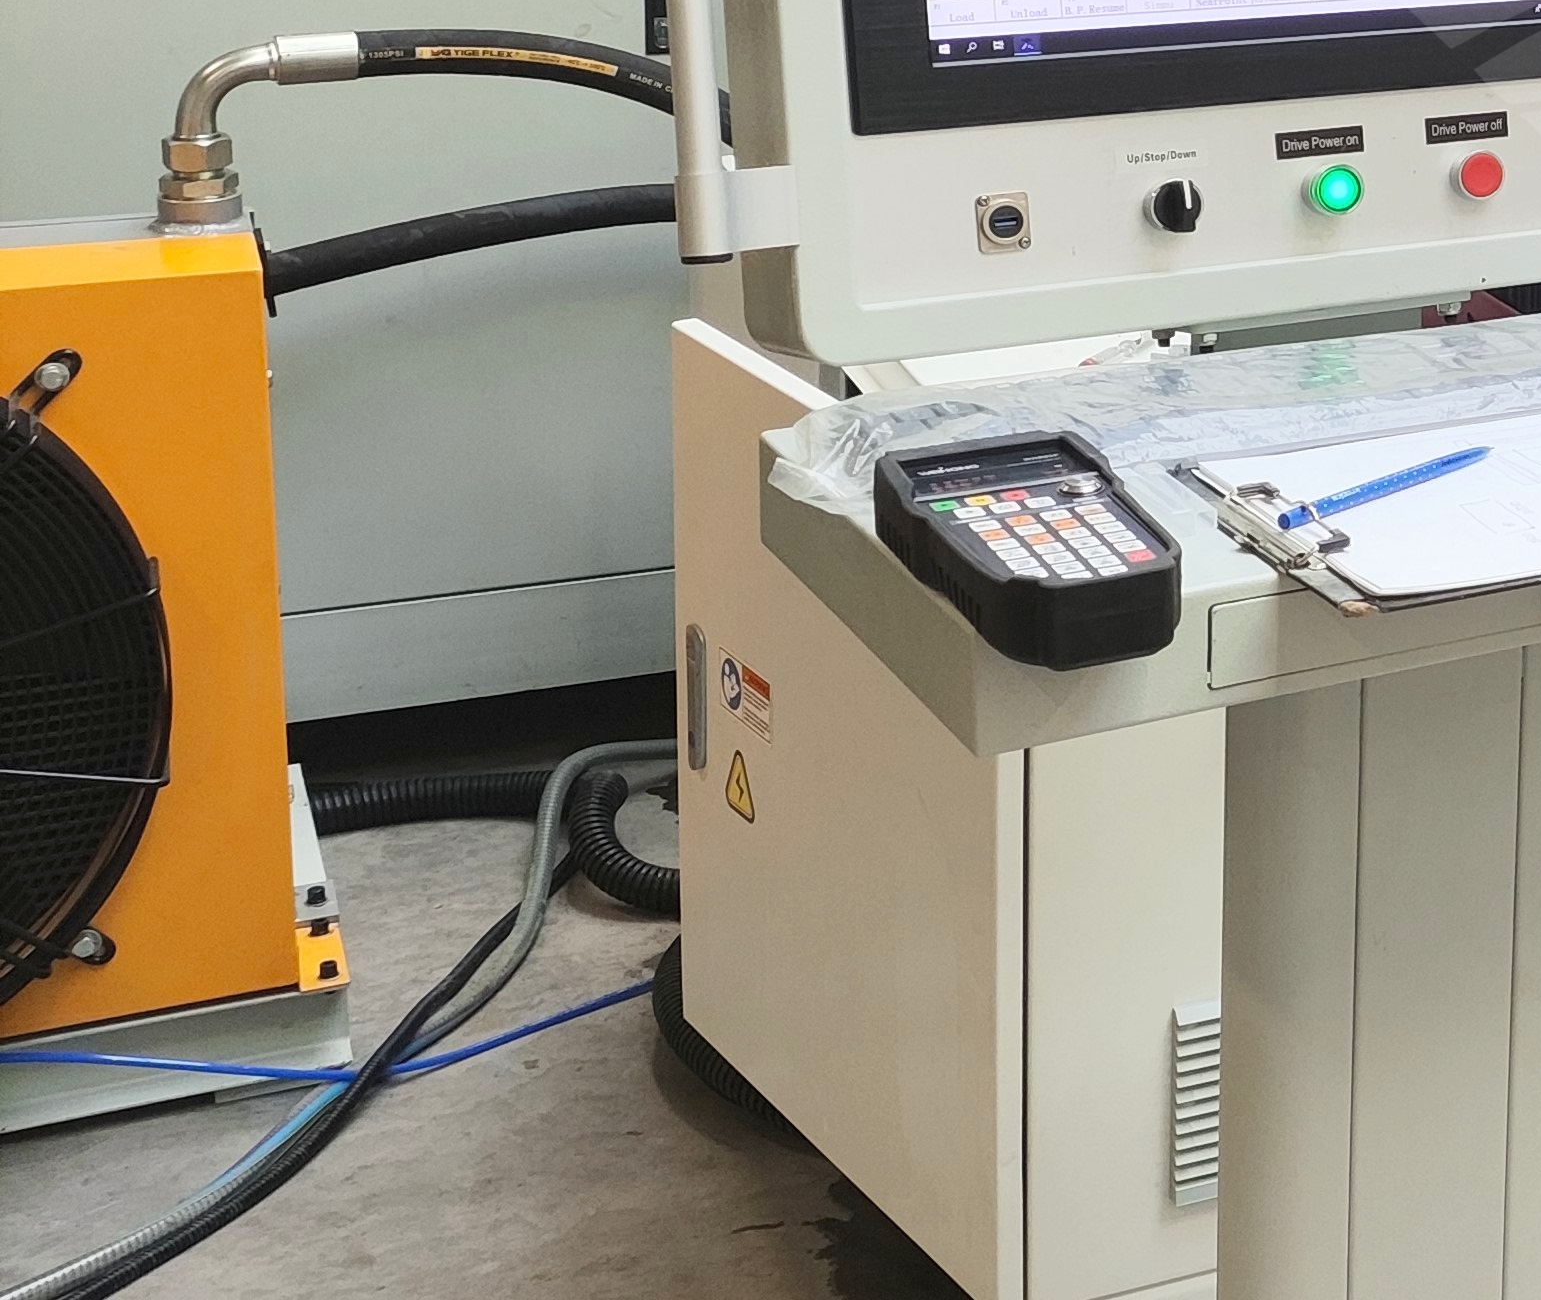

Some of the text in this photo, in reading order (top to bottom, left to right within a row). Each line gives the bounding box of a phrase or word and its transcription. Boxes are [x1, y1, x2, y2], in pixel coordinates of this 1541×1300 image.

[949, 13, 975, 22] Load
[1010, 9, 1048, 19] Unload
[482, 50, 513, 58] FLEX
[630, 72, 653, 86] MADE
[654, 80, 663, 89] IN
[1431, 118, 1504, 137] Drive Power off
[1282, 135, 1360, 152] Drive Power on
[1126, 150, 1197, 165] Up/Stop/Down
